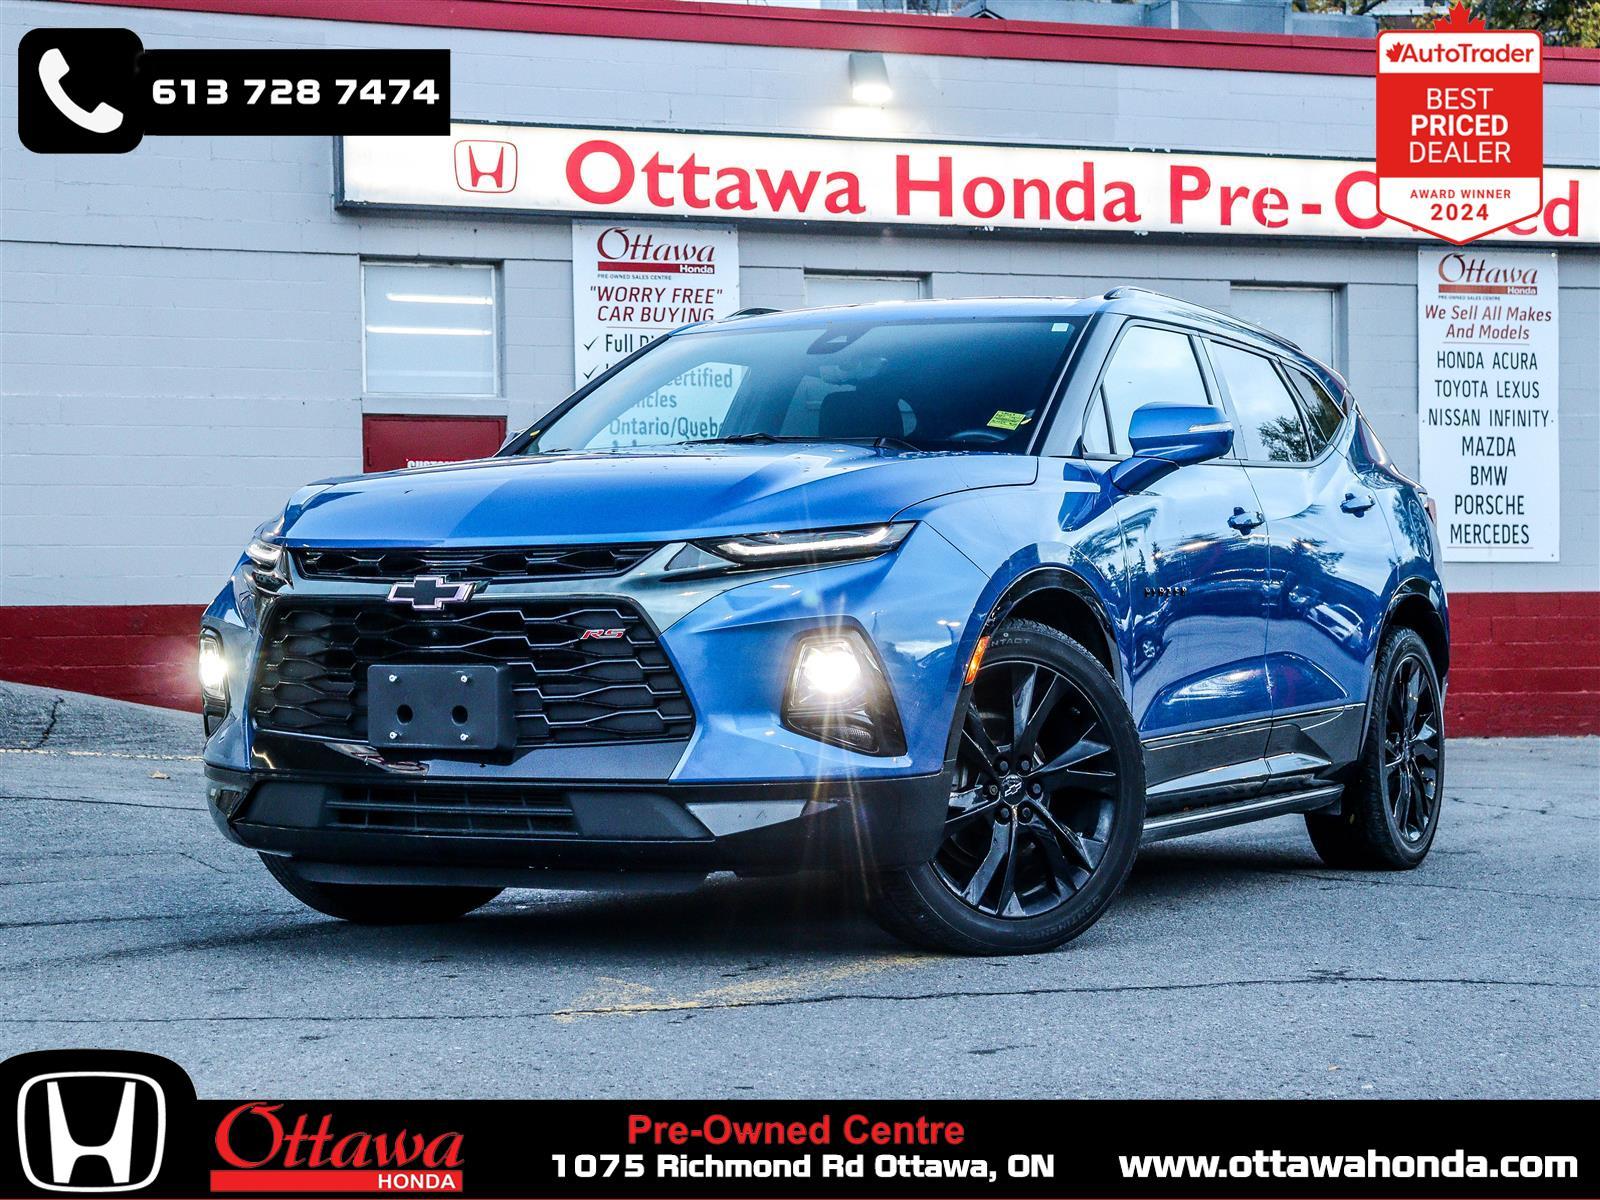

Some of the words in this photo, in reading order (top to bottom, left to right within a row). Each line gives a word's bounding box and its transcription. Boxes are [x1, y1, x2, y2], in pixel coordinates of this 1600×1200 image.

[565, 139, 867, 215] Ottawa
[895, 154, 1142, 223] Honda
[597, 226, 716, 263] Ottawa
[679, 264, 714, 274] Honda
[1438, 252, 1538, 284] Ottawa
[590, 286, 666, 303] "WORRY
[671, 287, 723, 304] FREE"
[1507, 286, 1537, 295] Honda
[597, 305, 635, 322] CAR
[640, 306, 715, 323] BUYING
[1425, 304, 1446, 320] We
[1451, 305, 1478, 320] Sell
[1482, 306, 1502, 321] All
[1506, 306, 1552, 322] Makes
[1445, 323, 1475, 339] And
[1478, 324, 1530, 340] Models
[605, 333, 633, 353] Full
[1436, 351, 1484, 369] HONDA
[1492, 352, 1538, 370] ACURA
[665, 367, 733, 388] ertified
[1435, 379, 1489, 398] TOYOTA
[1497, 381, 1540, 398] LEXUS
[637, 390, 677, 408] icles
[1428, 408, 1481, 426] NISSAN
[1489, 409, 1549, 427] INFINITY
[609, 416, 720, 439] Ontario/Queb
[1461, 436, 1516, 457] MAZDA
[1470, 465, 1508, 486] BMW
[1454, 494, 1525, 515] PORSCHE
[1450, 523, 1530, 544] MERCEDES
[580, 629, 626, 640] RS
